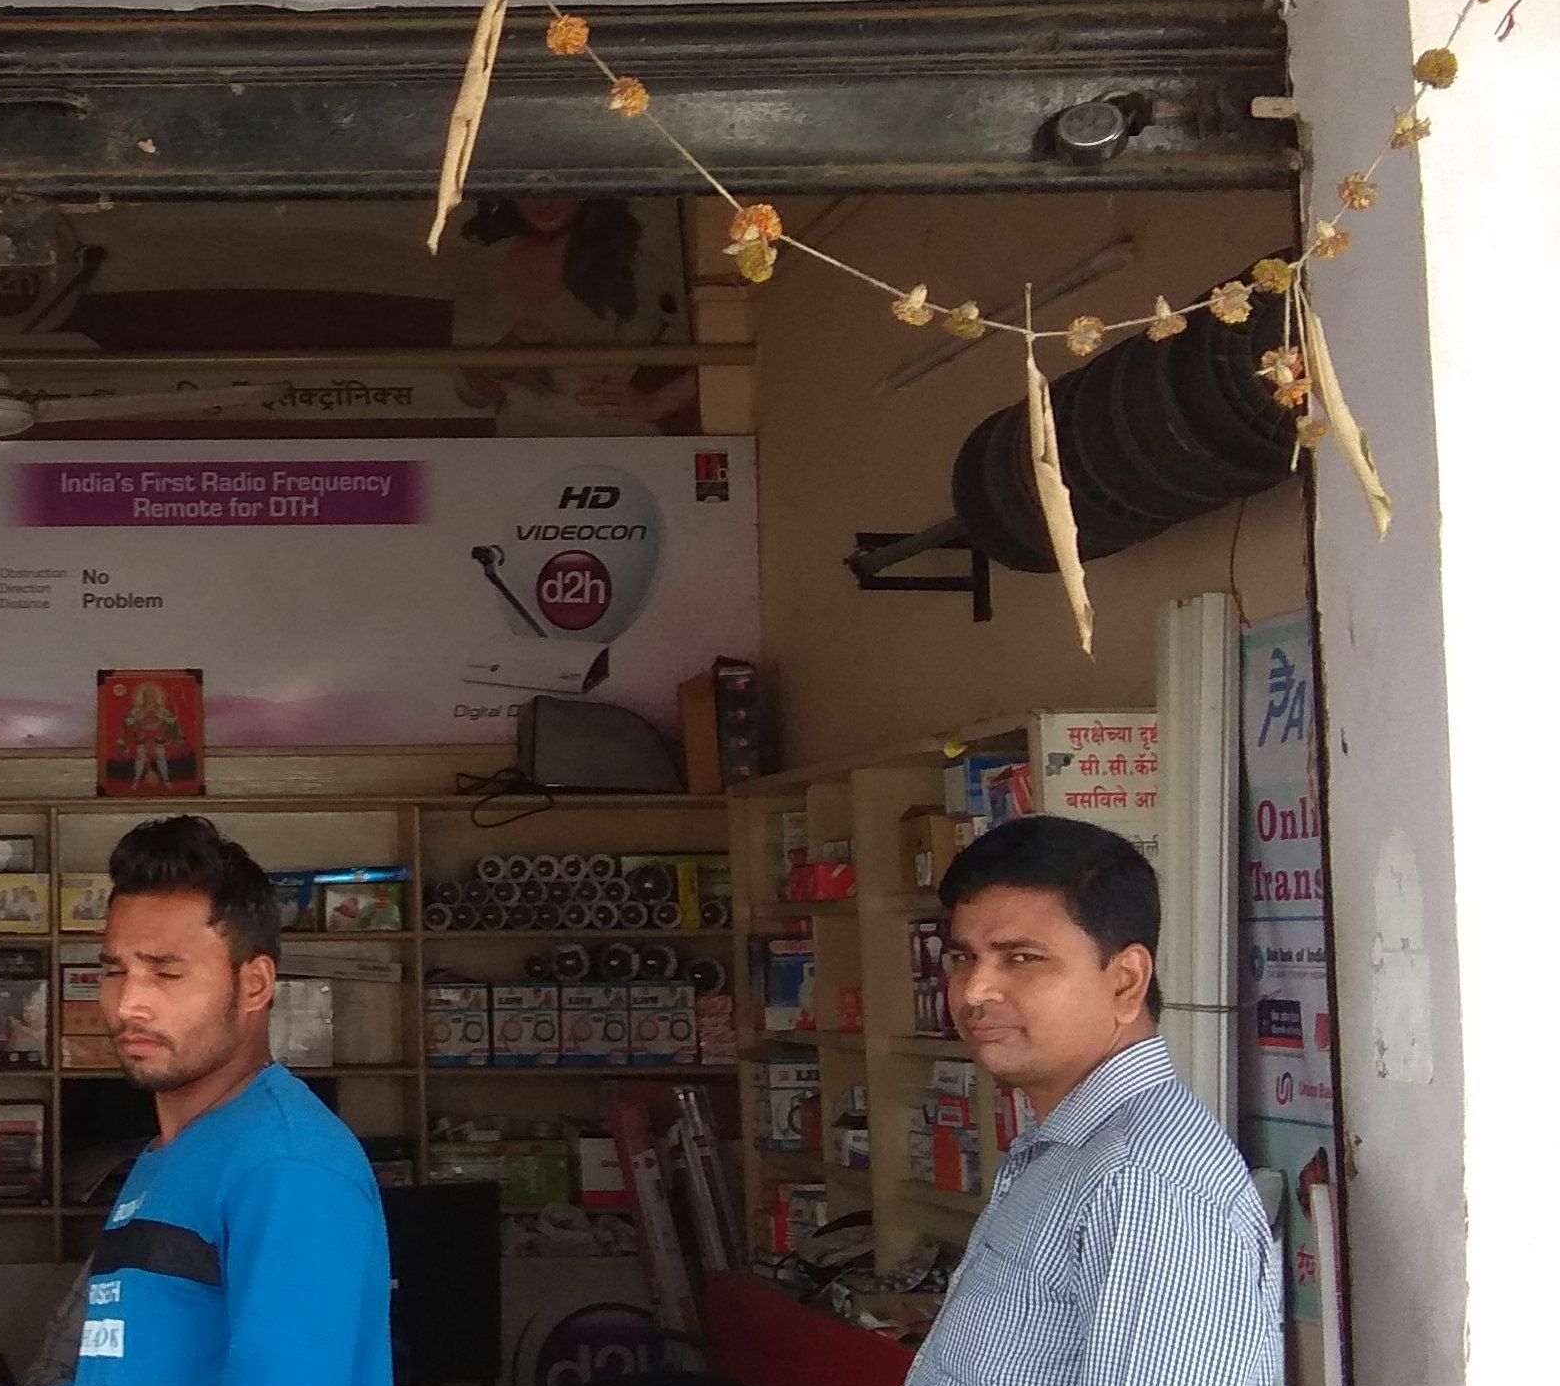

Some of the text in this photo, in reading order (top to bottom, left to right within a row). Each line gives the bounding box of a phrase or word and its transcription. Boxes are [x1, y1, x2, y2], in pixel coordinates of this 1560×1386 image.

[60, 470, 392, 497] India's First Radio Frequency
[133, 496, 320, 519] Remote for DTH
[558, 485, 621, 509] HD
[516, 524, 647, 542] VIDEOCON
[81, 568, 110, 586] No
[541, 569, 607, 605] d2h
[82, 592, 164, 610] Problem
[1067, 719, 1133, 751] सुरक्षेच्या
[1065, 784, 1127, 809] बसविले
